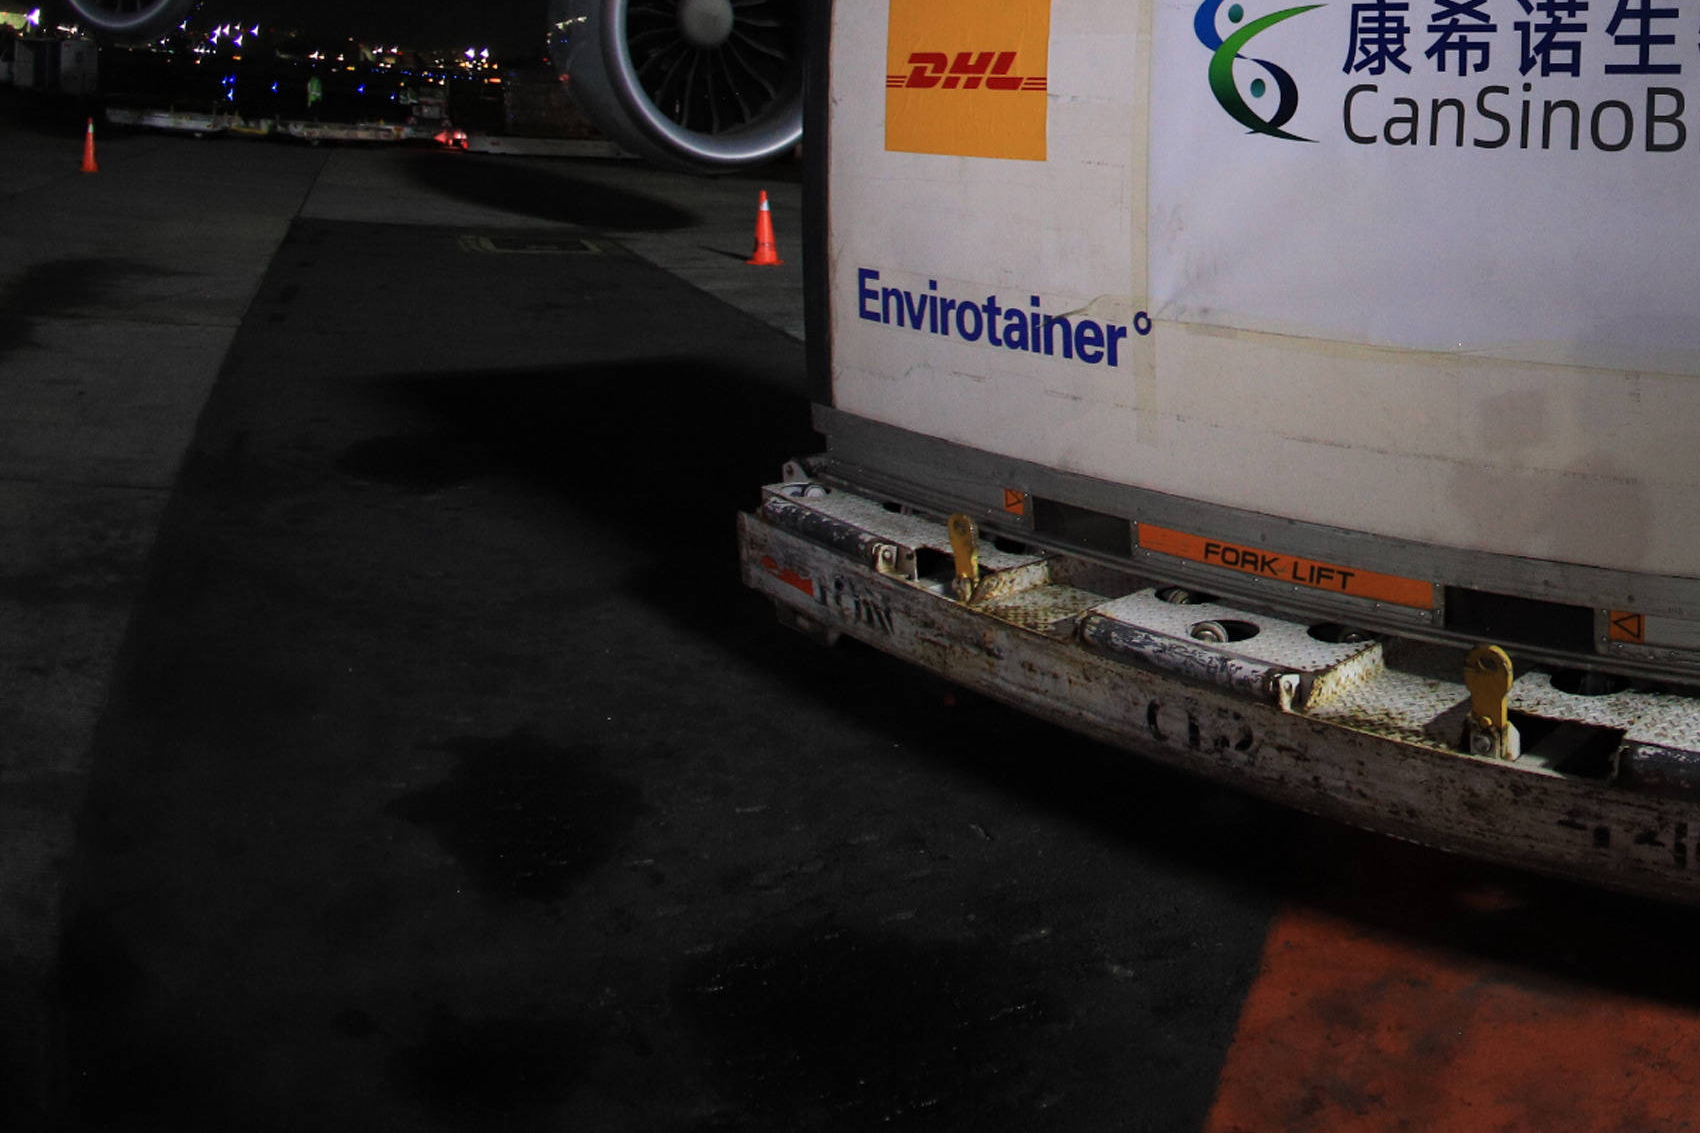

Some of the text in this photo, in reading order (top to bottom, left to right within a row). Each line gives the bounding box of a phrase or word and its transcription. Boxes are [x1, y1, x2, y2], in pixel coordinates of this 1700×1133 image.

[906, 51, 1025, 91] DHL
[1204, 541, 1355, 591] FORK LIFT
